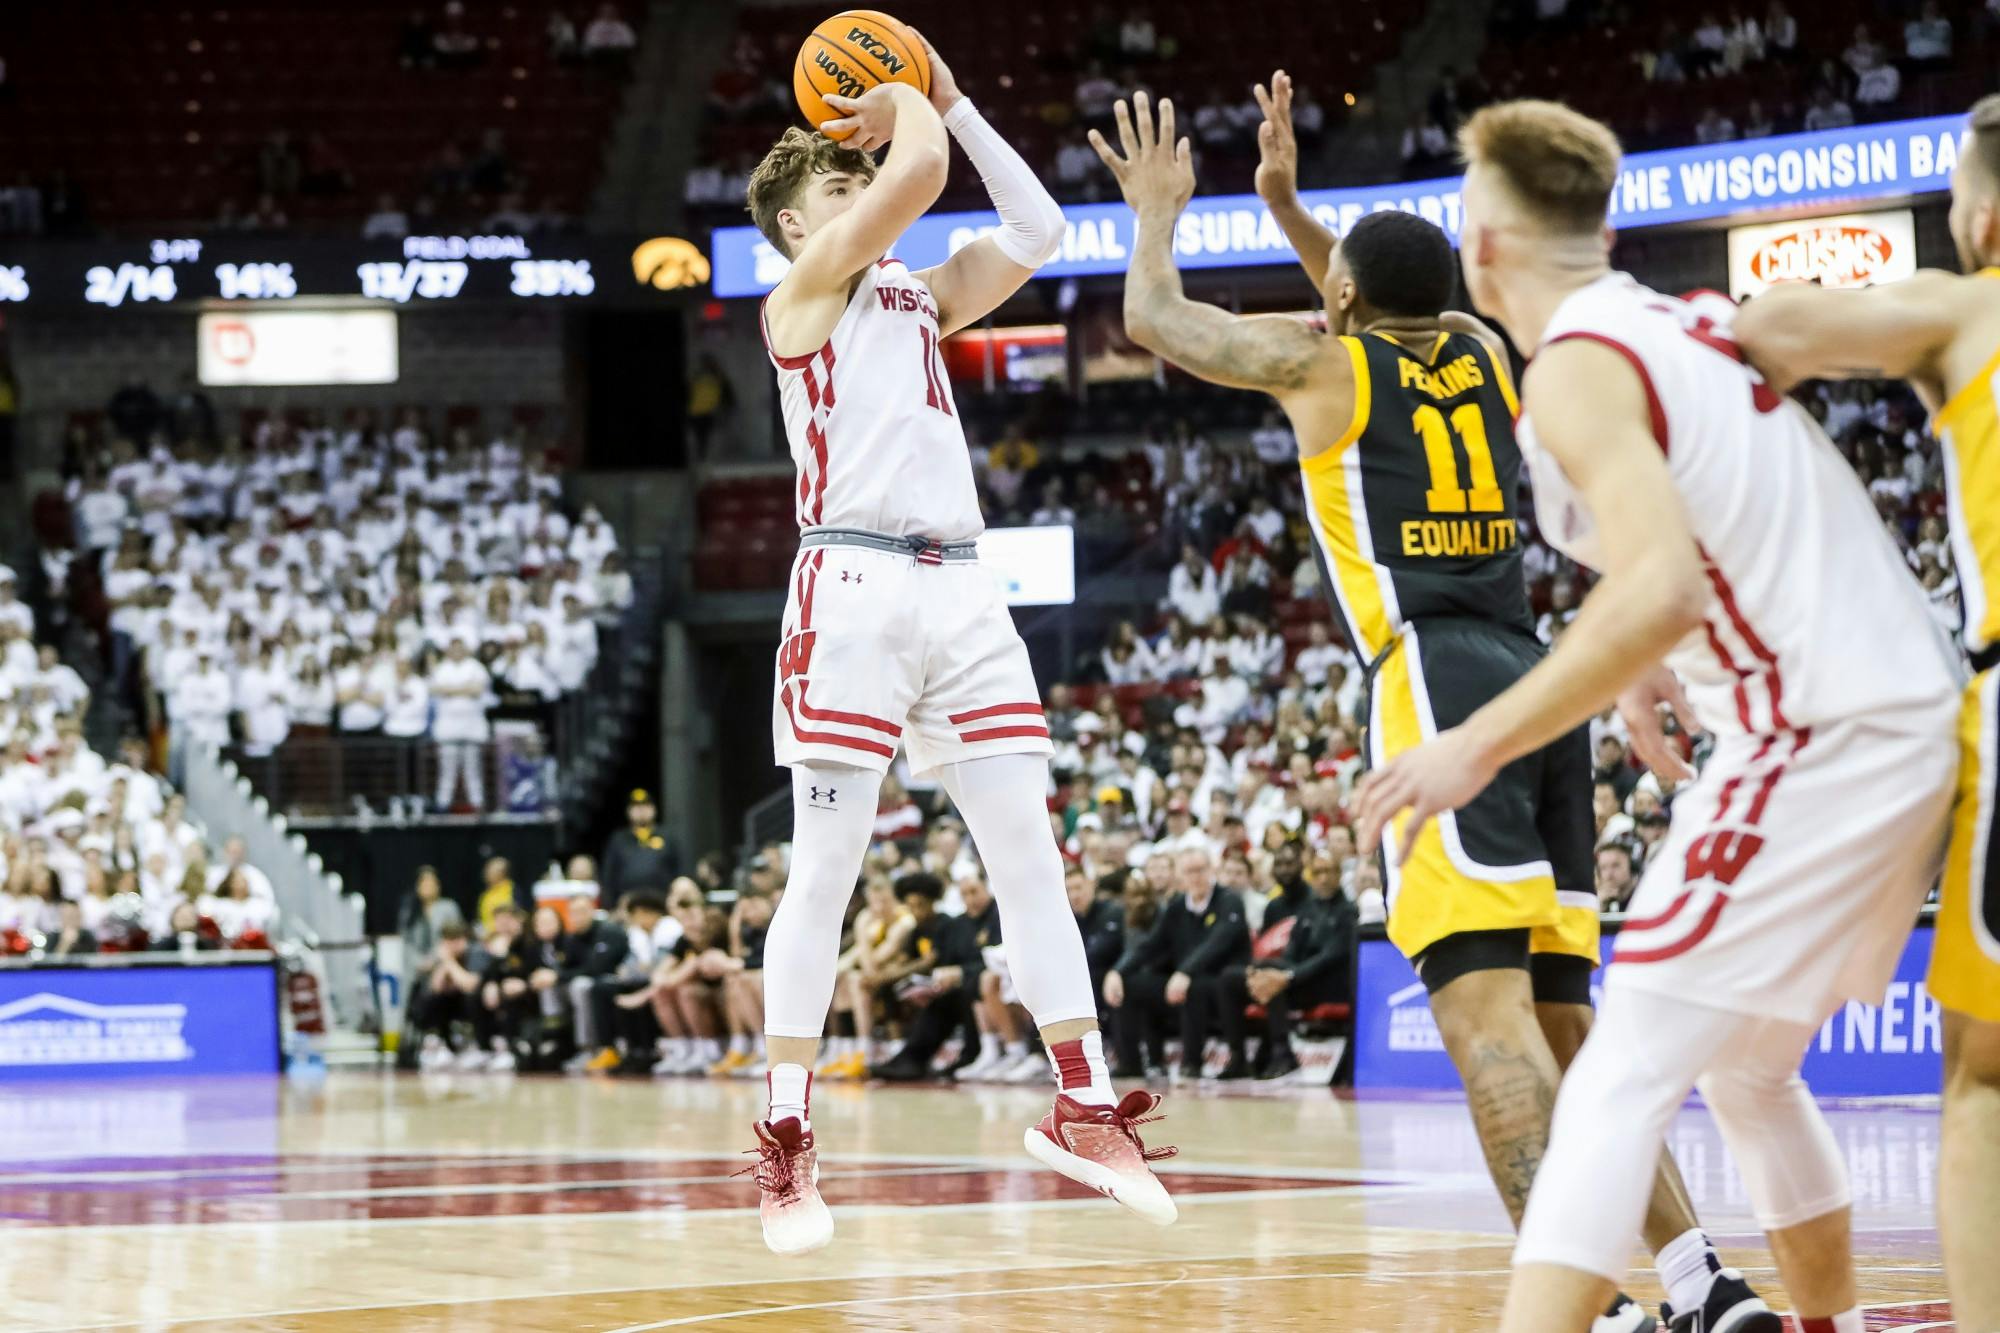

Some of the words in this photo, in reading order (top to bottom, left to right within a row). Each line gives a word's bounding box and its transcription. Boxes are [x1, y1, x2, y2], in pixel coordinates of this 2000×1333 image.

[846, 27, 906, 76] NCAA
[1680, 138, 1897, 206] WISCONSIN
[1760, 229, 1888, 282] COUSINS
[85, 262, 178, 307] 2/14
[214, 262, 298, 300] 14%
[1412, 403, 1504, 512] 11
